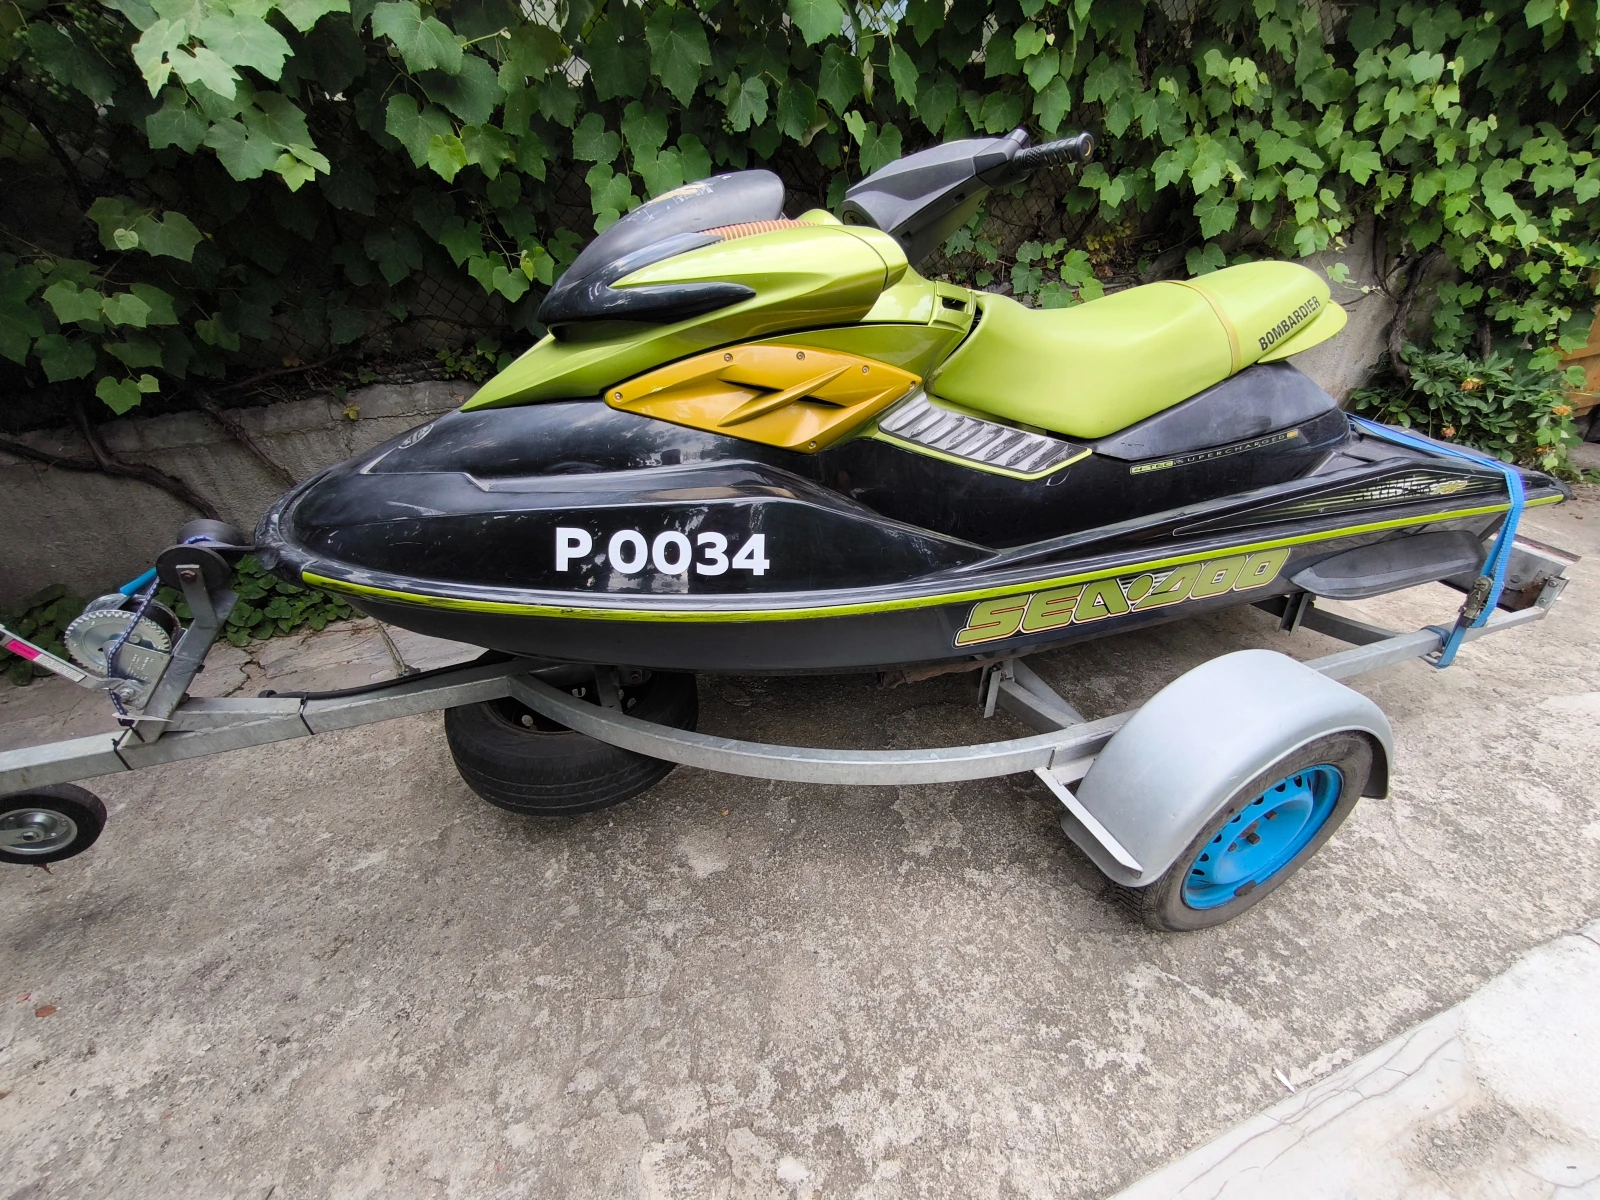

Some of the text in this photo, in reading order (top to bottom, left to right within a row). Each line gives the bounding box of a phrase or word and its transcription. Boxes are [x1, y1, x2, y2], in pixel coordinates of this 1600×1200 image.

[1258, 296, 1321, 351] BOMBARDIER
[1176, 434, 1285, 464] SUPERCHARGED
[555, 527, 770, 576] P 0034
